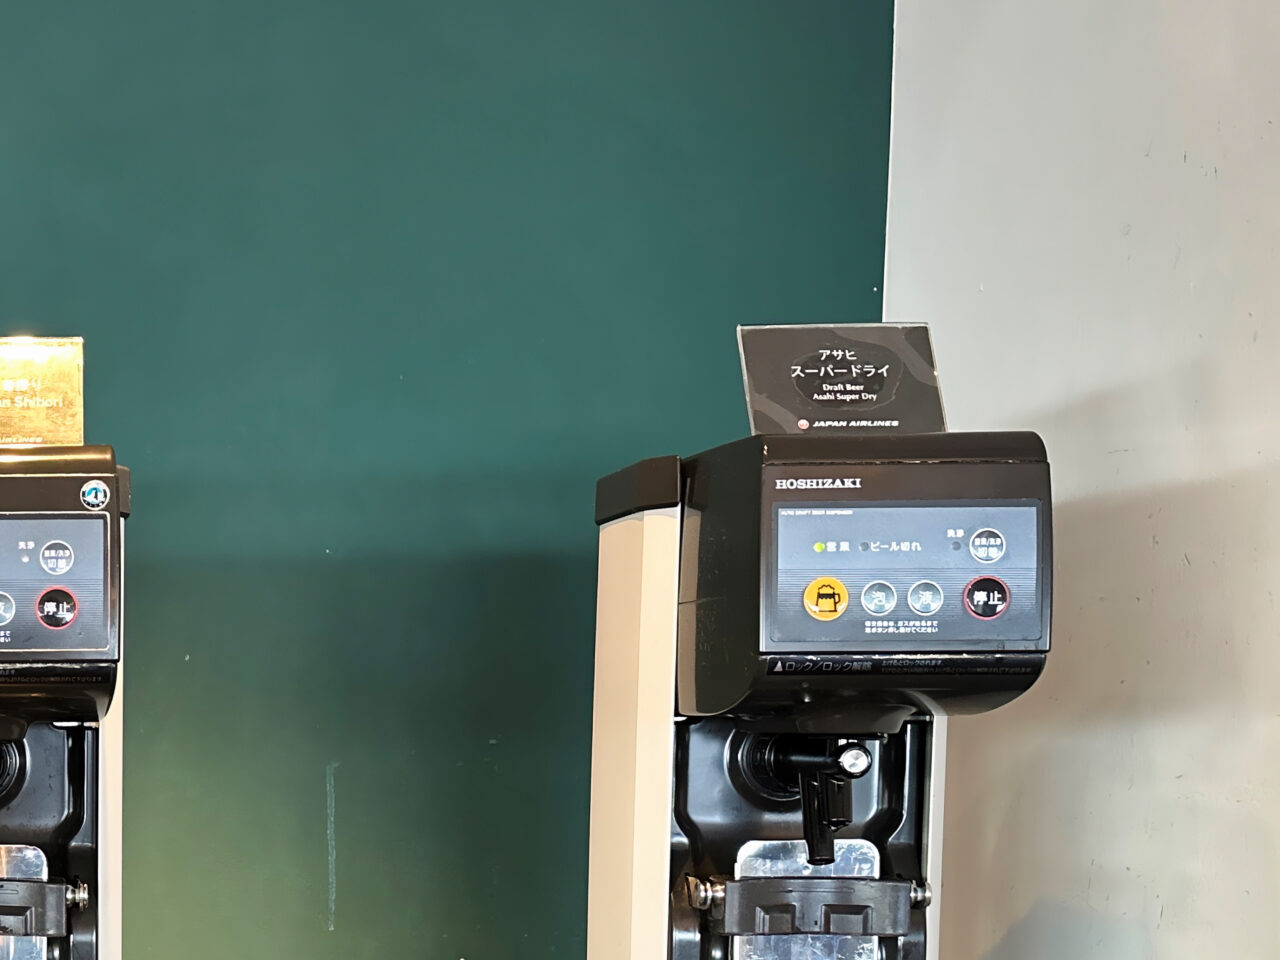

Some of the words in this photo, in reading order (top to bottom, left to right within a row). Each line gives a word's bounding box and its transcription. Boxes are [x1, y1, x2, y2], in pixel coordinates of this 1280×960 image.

[818, 350, 857, 360] アサヒ
[791, 364, 890, 378] スーパードライ
[822, 384, 844, 392] Draft
[846, 384, 864, 392] Beer
[14, 396, 63, 408] Shibori
[812, 392, 835, 400] Asahi
[836, 393, 860, 402] Super
[862, 393, 877, 402] Dry
[812, 420, 848, 428] JAPAN
[849, 420, 900, 428] AIRLINES
[775, 478, 862, 490] HOSHIZAKI
[870, 542, 922, 552] ビール切れ
[974, 590, 1003, 606] 停止
[44, 602, 70, 616] 停止
